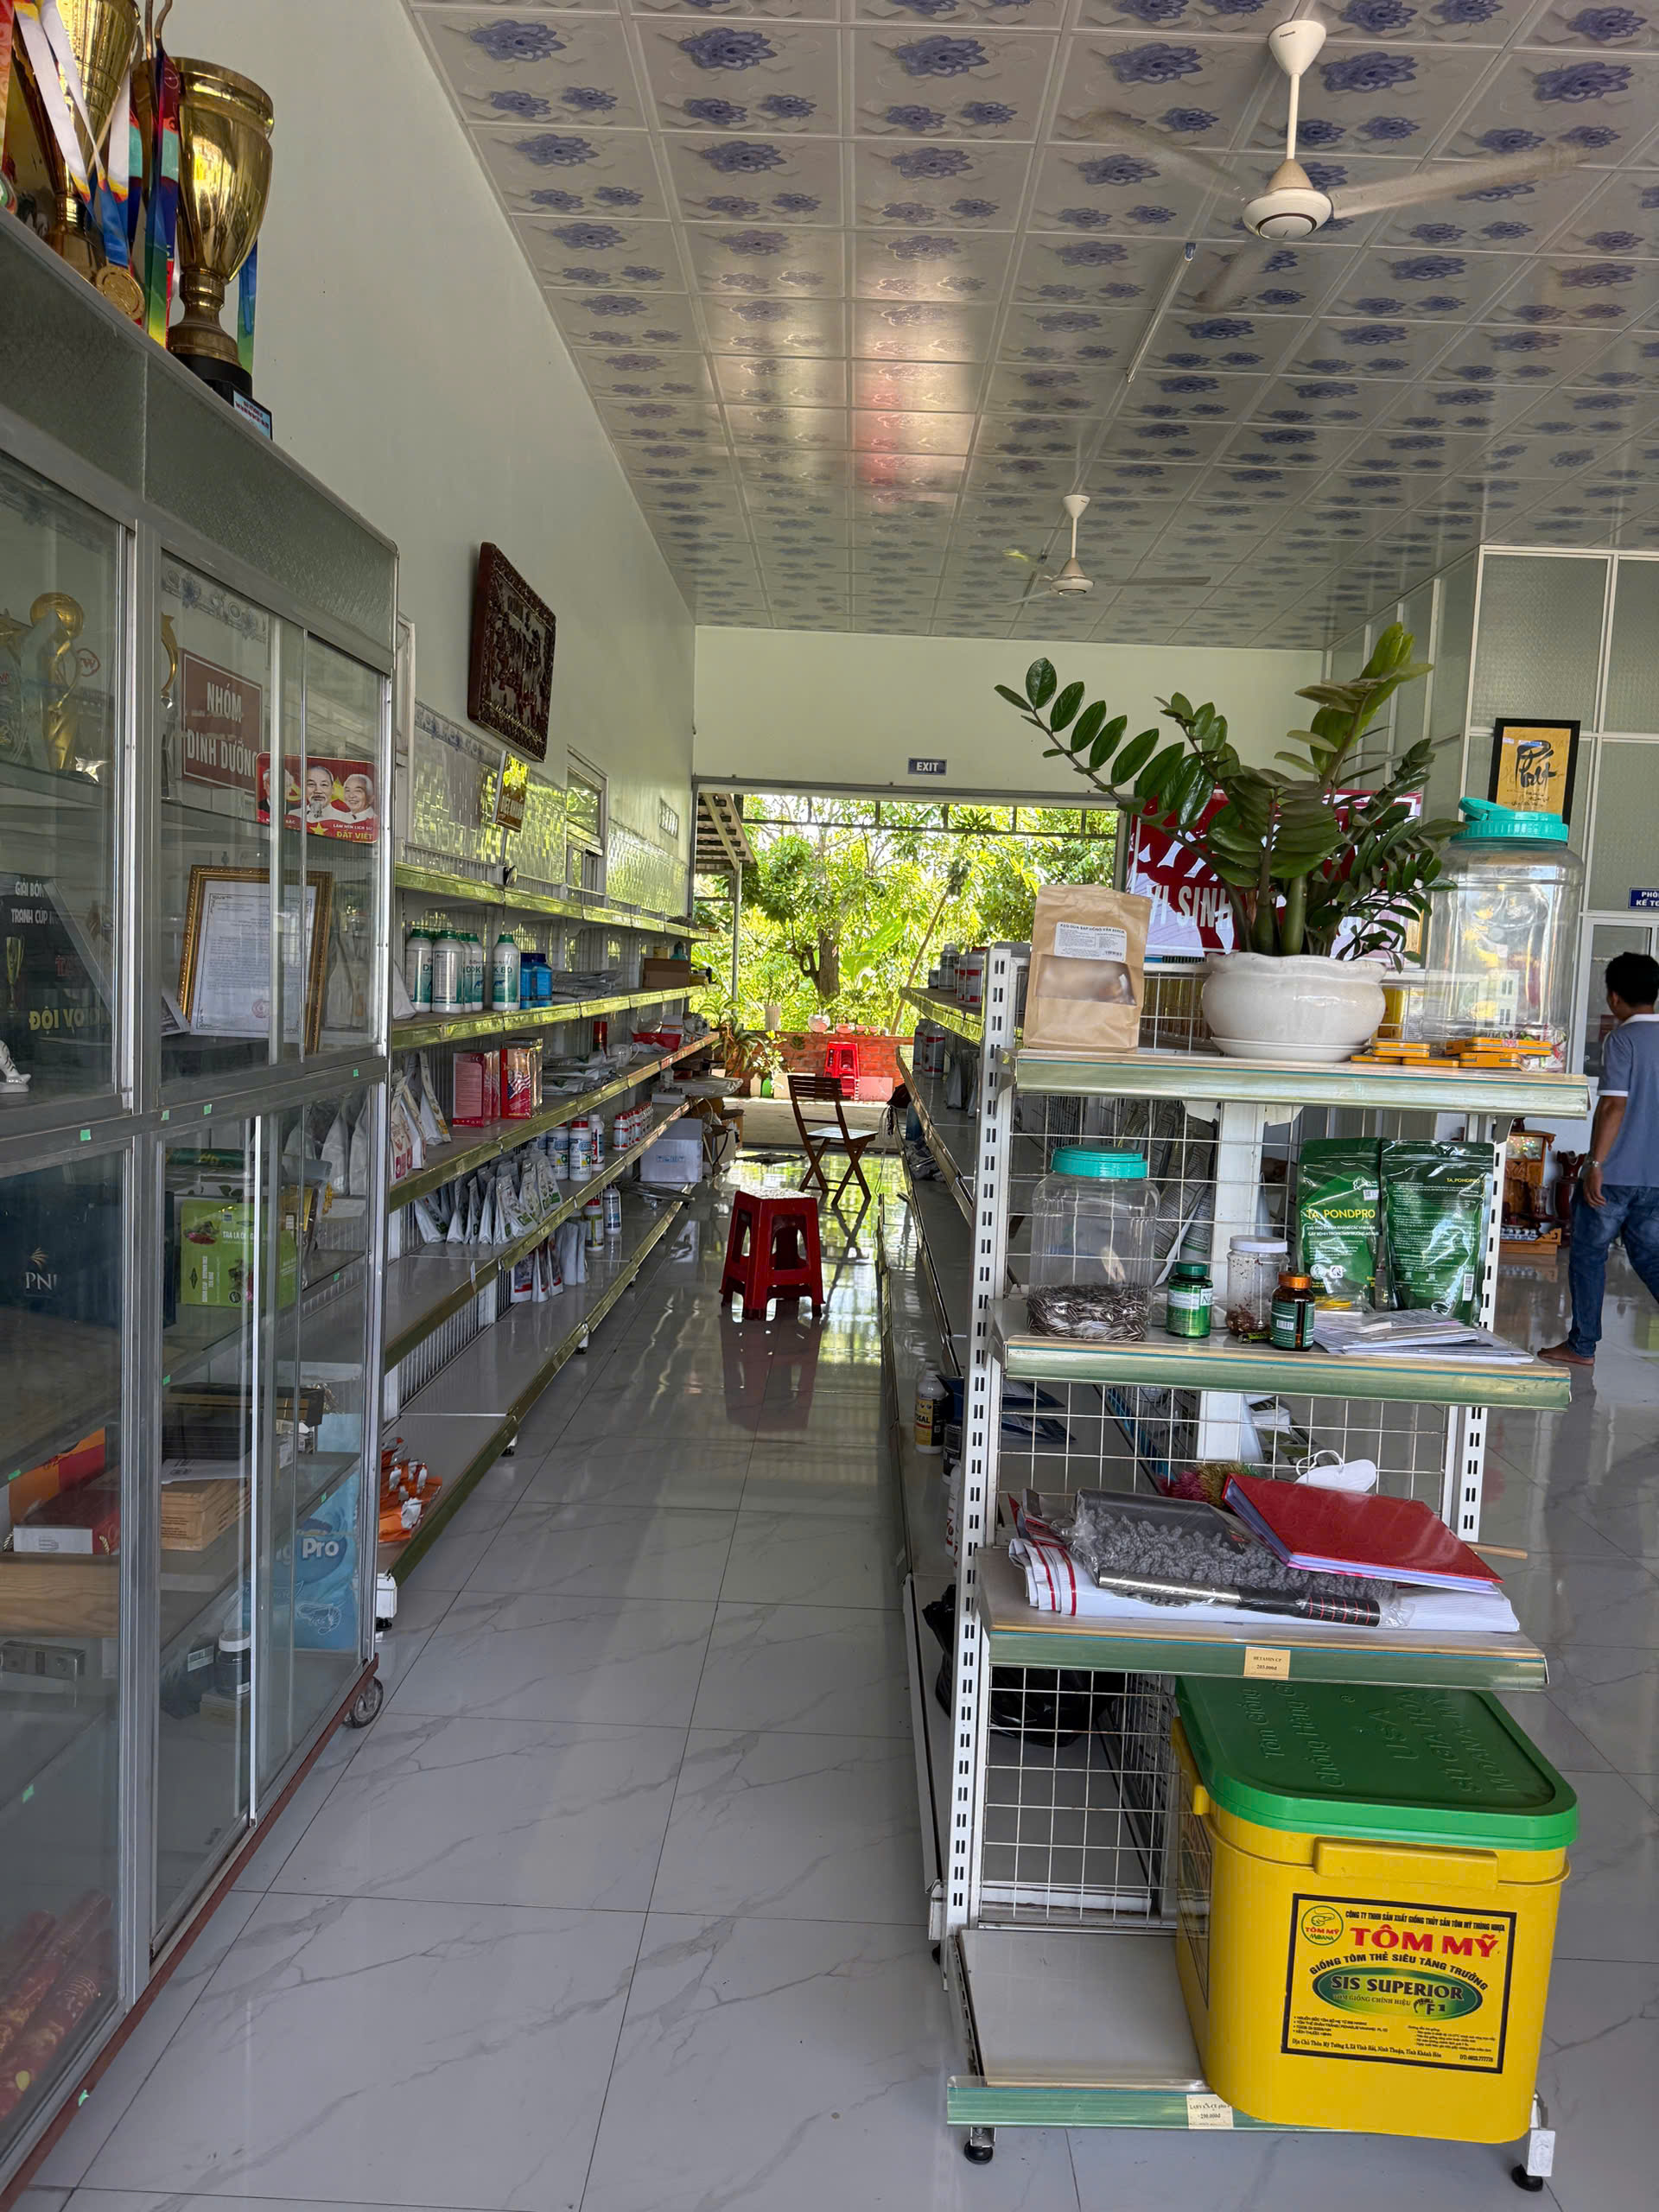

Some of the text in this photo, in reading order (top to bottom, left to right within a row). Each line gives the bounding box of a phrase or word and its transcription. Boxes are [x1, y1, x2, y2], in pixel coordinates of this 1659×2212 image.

[207, 682, 242, 723] NHÓM
[188, 728, 216, 766] DINH
[917, 761, 938, 772] EXIT
[1636, 898, 1648, 906] KẾ
[11, 908, 33, 924] TRANH
[35, 906, 48, 925] CÚP
[29, 1006, 60, 1034] ĐỘI
[302, 1537, 340, 1559] Pro
[1350, 1923, 1499, 1958] TÔM MỸ
[1309, 1950, 1489, 1991] GIỐNG TÔM THẺ SIÊU TĂNG TRƯỞNG
[1332, 1975, 1464, 2001] SIS SUPERIOR
[1349, 1994, 1370, 2003] GIỐNG
[1371, 1995, 1393, 2004] CHÍNH
